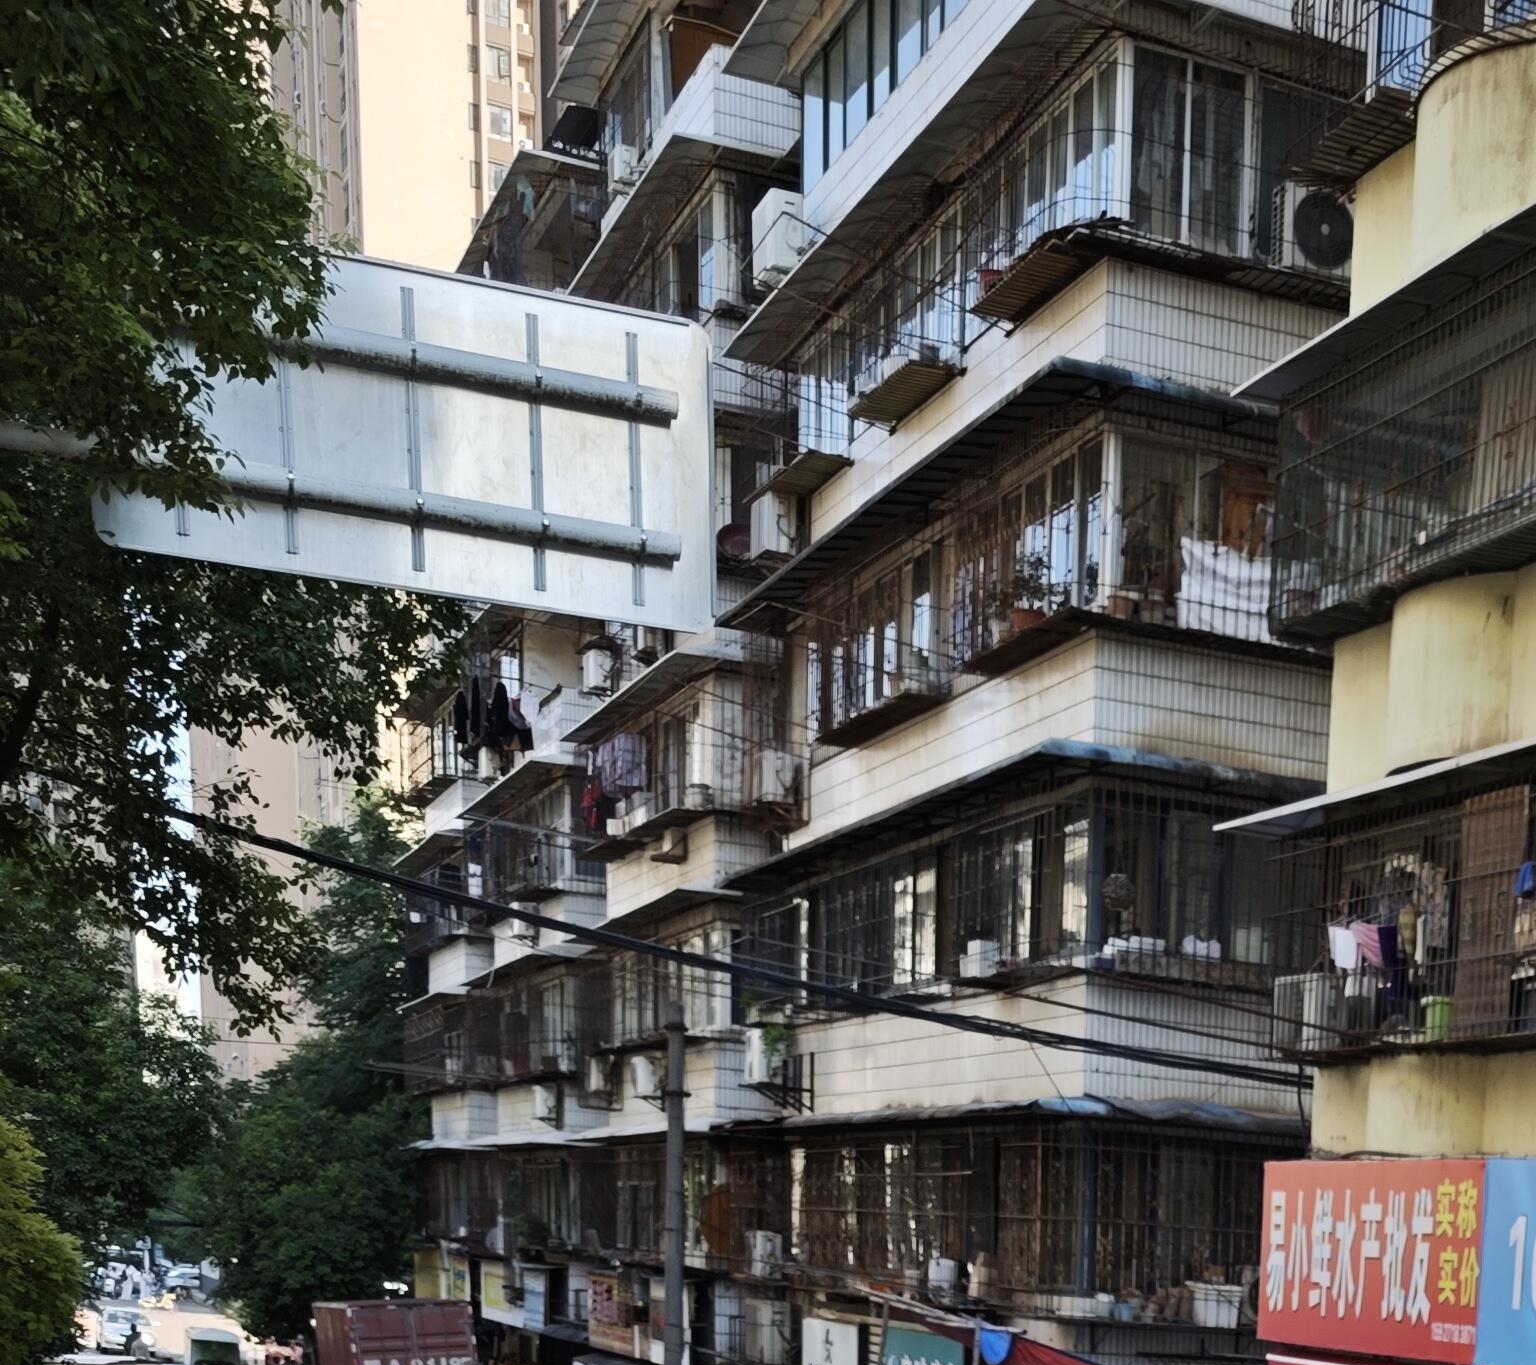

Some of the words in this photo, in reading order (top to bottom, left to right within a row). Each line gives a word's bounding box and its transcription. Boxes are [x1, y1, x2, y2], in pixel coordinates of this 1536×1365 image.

[1435, 1178, 1479, 1240] 实称
[1265, 1187, 1434, 1326] 易小鲜水产批发
[1437, 1245, 1481, 1309] 实价
